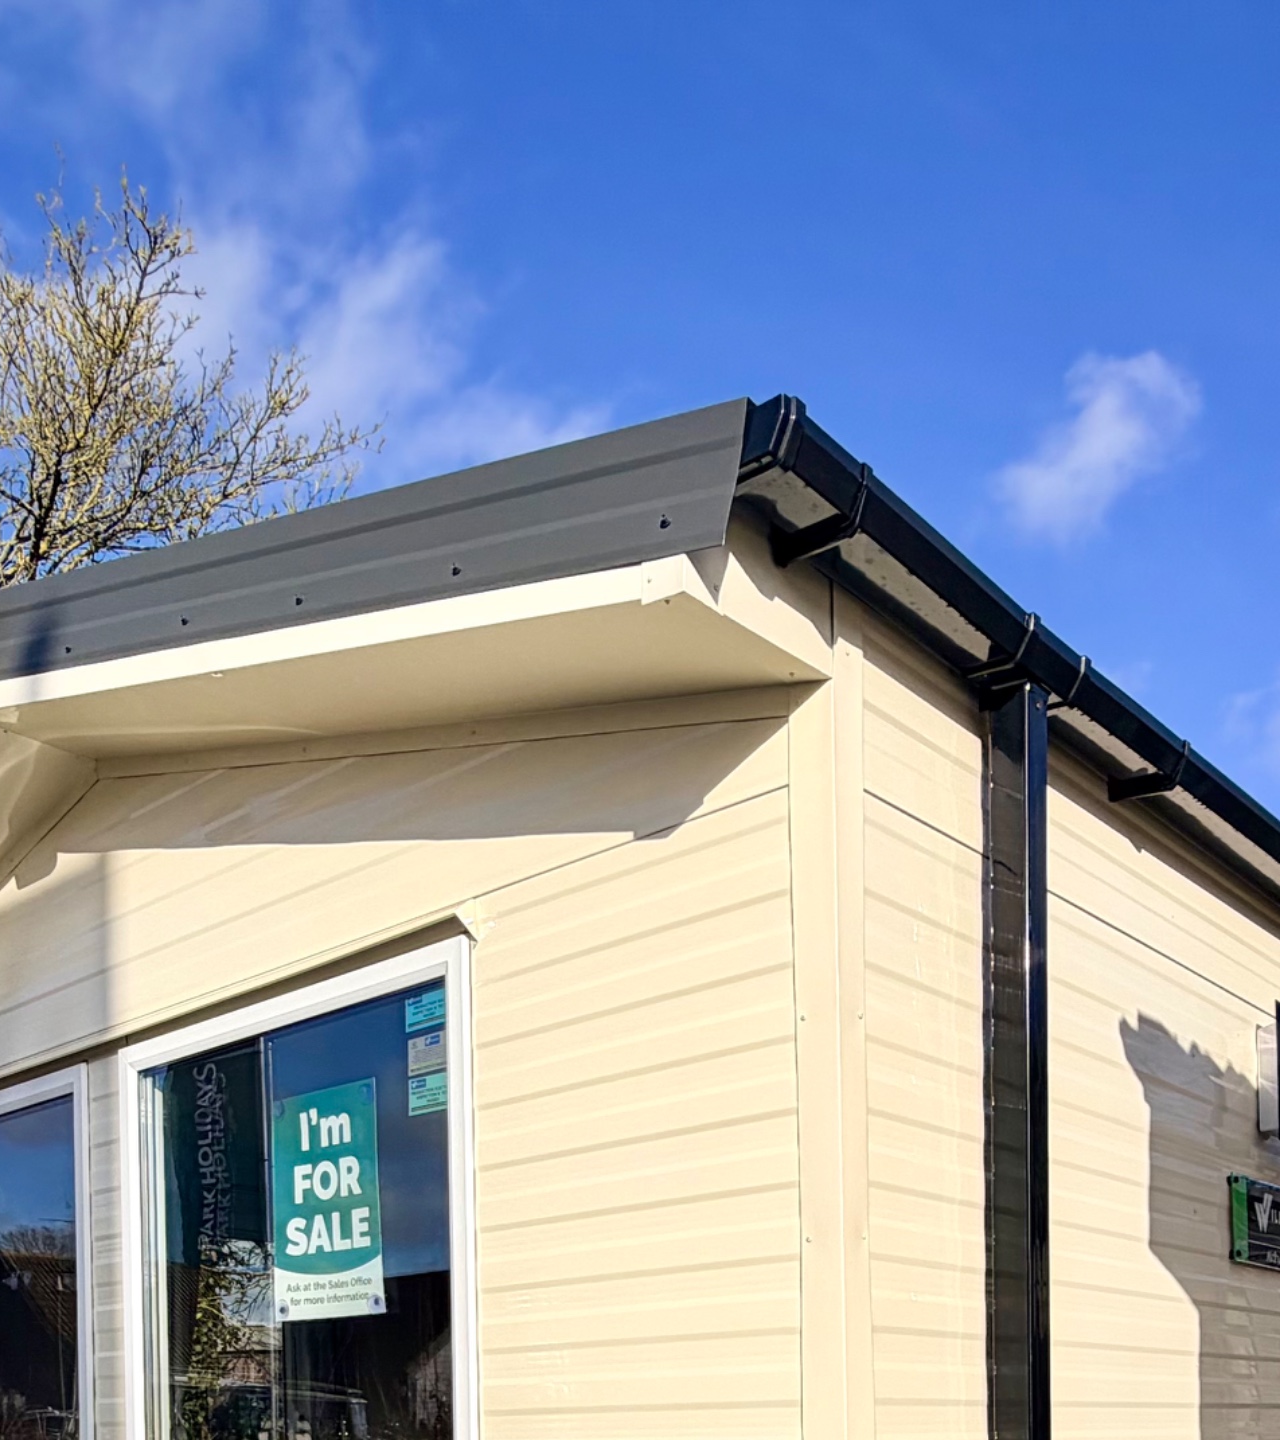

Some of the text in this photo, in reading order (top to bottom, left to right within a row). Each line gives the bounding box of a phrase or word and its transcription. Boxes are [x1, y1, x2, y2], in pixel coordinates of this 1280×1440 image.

[299, 1107, 352, 1152] I'm
[192, 1063, 217, 1250] PARK HOLIDAYS
[293, 1155, 363, 1205] FOR
[285, 1206, 371, 1257] SALE
[286, 1276, 373, 1293] Ask at the Sales Office
[289, 1295, 302, 1307] for
[303, 1295, 325, 1305] more
